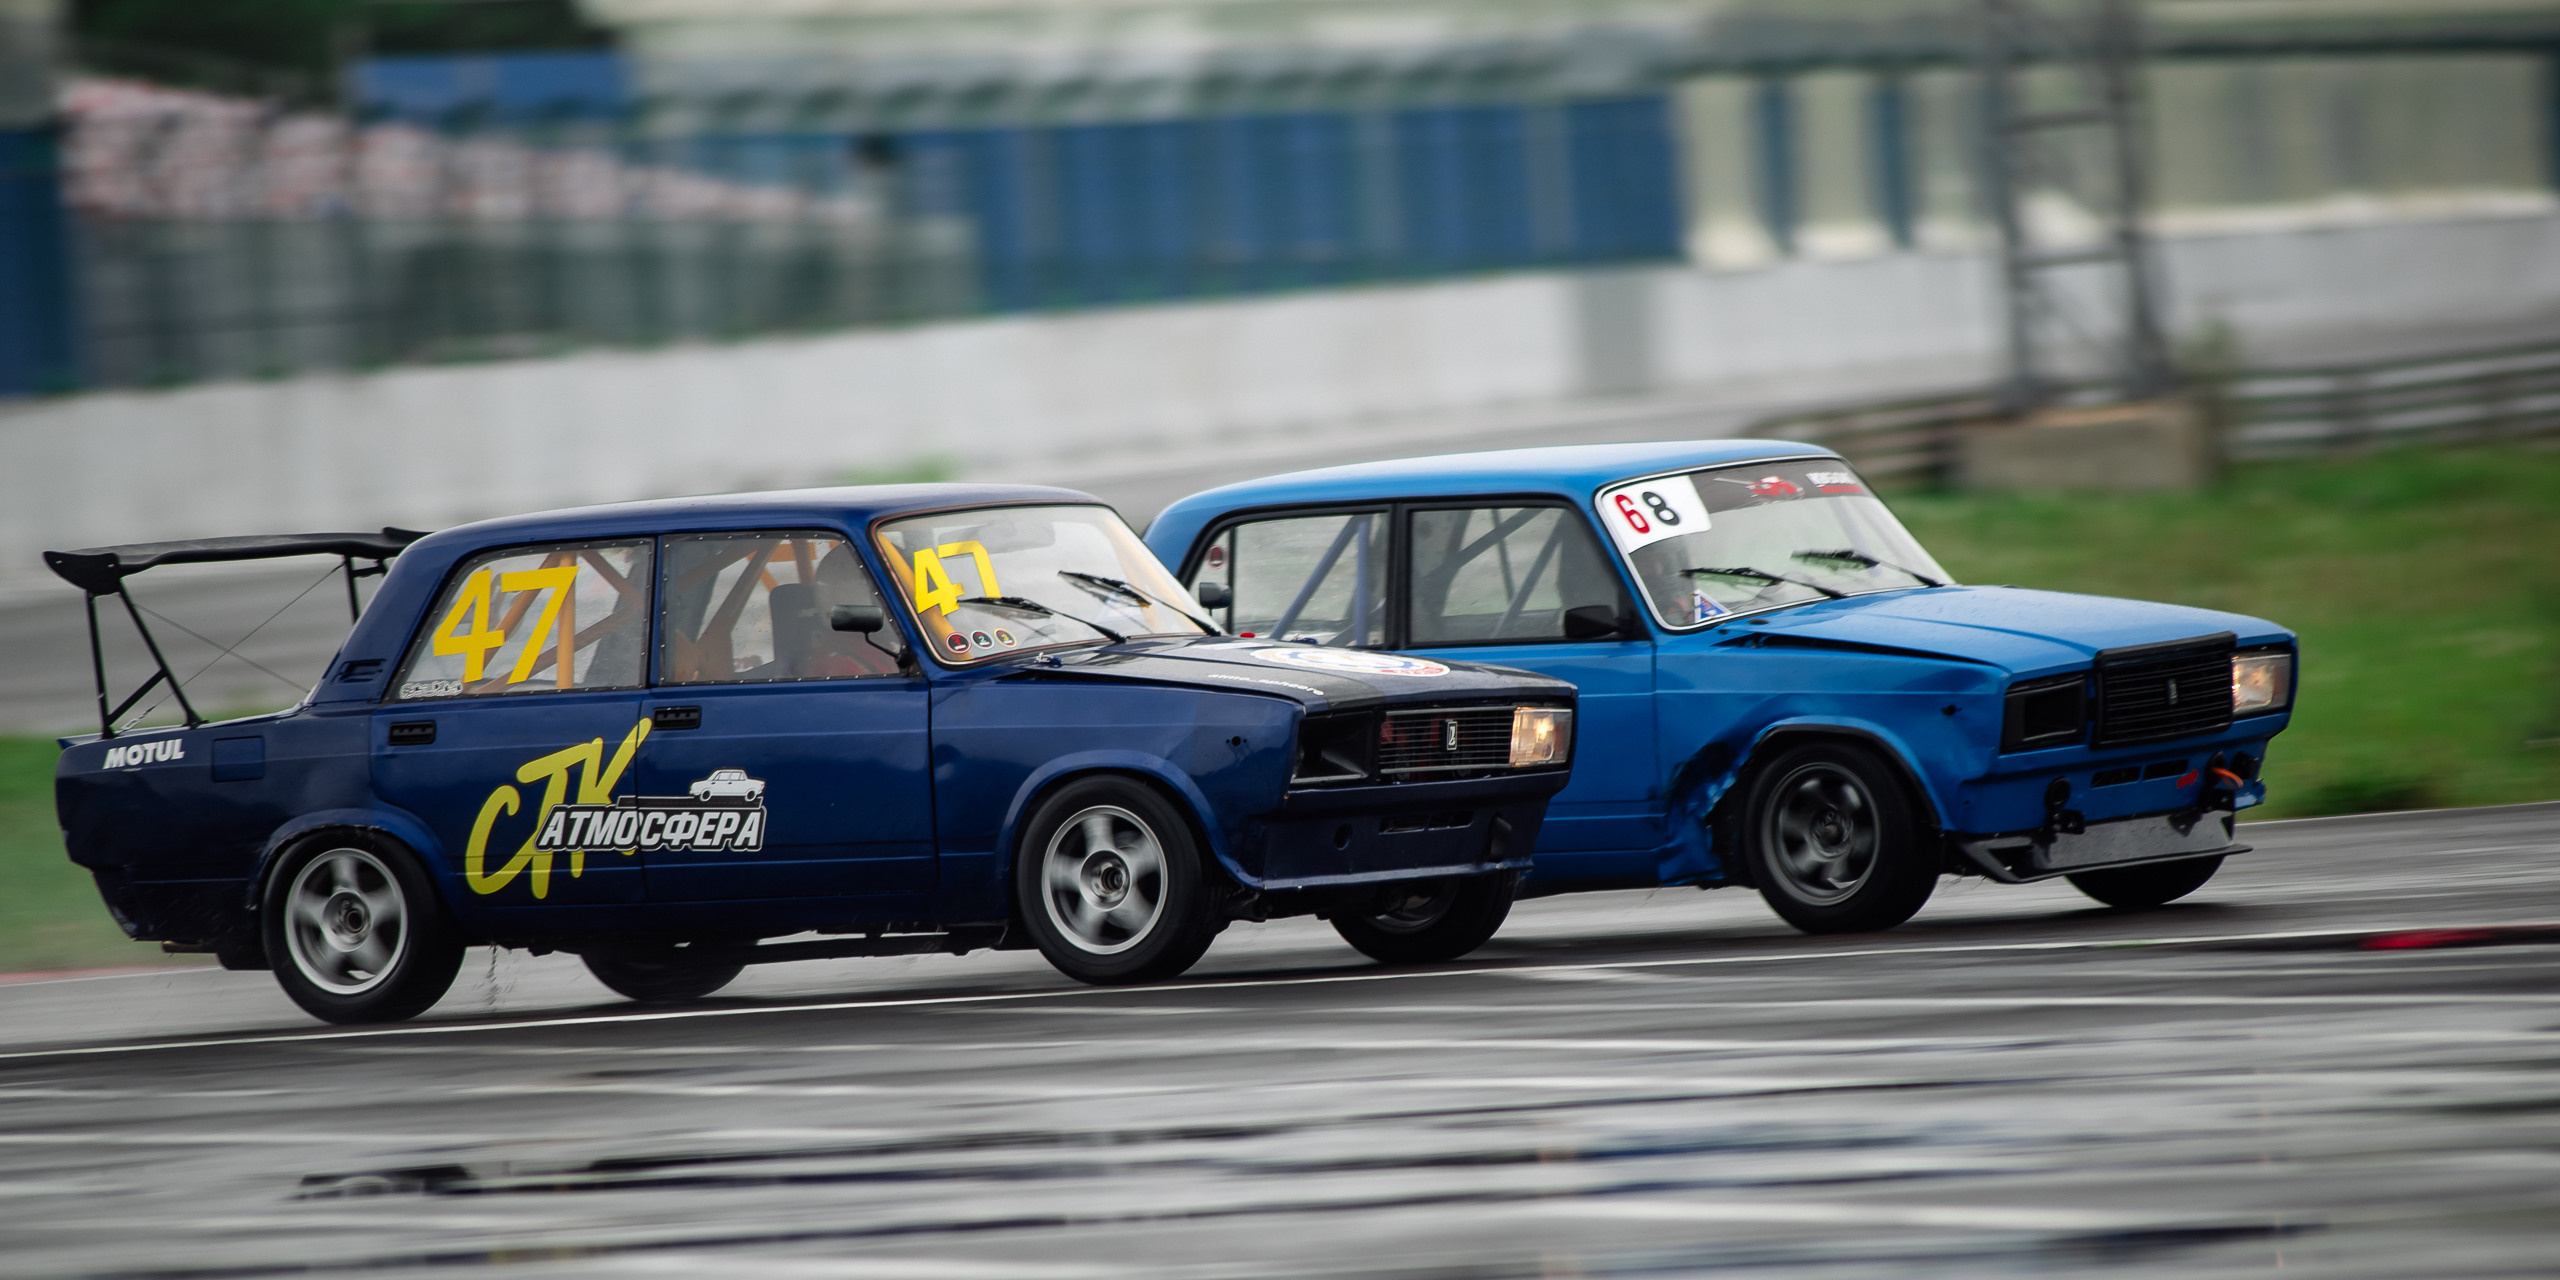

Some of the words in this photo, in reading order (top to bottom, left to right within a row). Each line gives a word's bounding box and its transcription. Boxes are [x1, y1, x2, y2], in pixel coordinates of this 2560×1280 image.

[1614, 491, 1680, 534] 68
[914, 540, 1002, 617] 47
[433, 566, 580, 684] 47
[102, 738, 186, 769] MOTUL
[538, 811, 762, 847] АТМОСФЕРА
